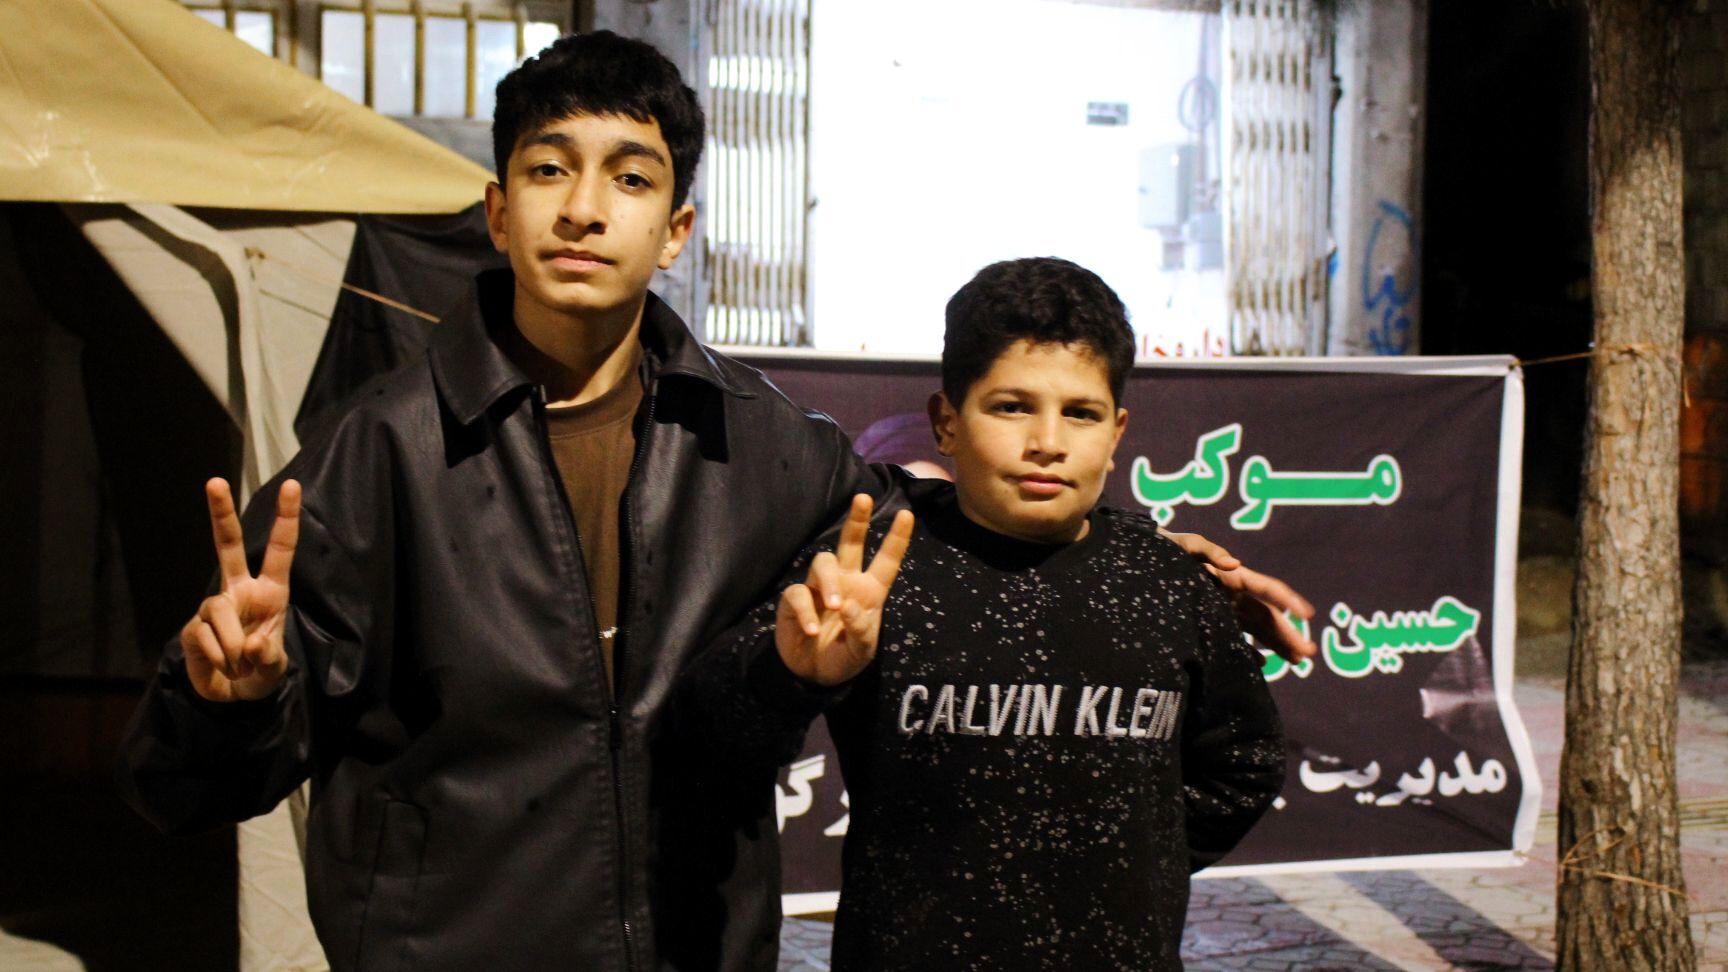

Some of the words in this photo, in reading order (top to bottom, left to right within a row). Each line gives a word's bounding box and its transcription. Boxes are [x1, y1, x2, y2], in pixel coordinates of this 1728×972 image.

[1131, 423, 1402, 530] موکب
[1321, 596, 1481, 678] حسین
[899, 684, 1063, 737] CALVIN
[1074, 685, 1182, 742] KLEIN
[1299, 751, 1507, 807] مدیریت
